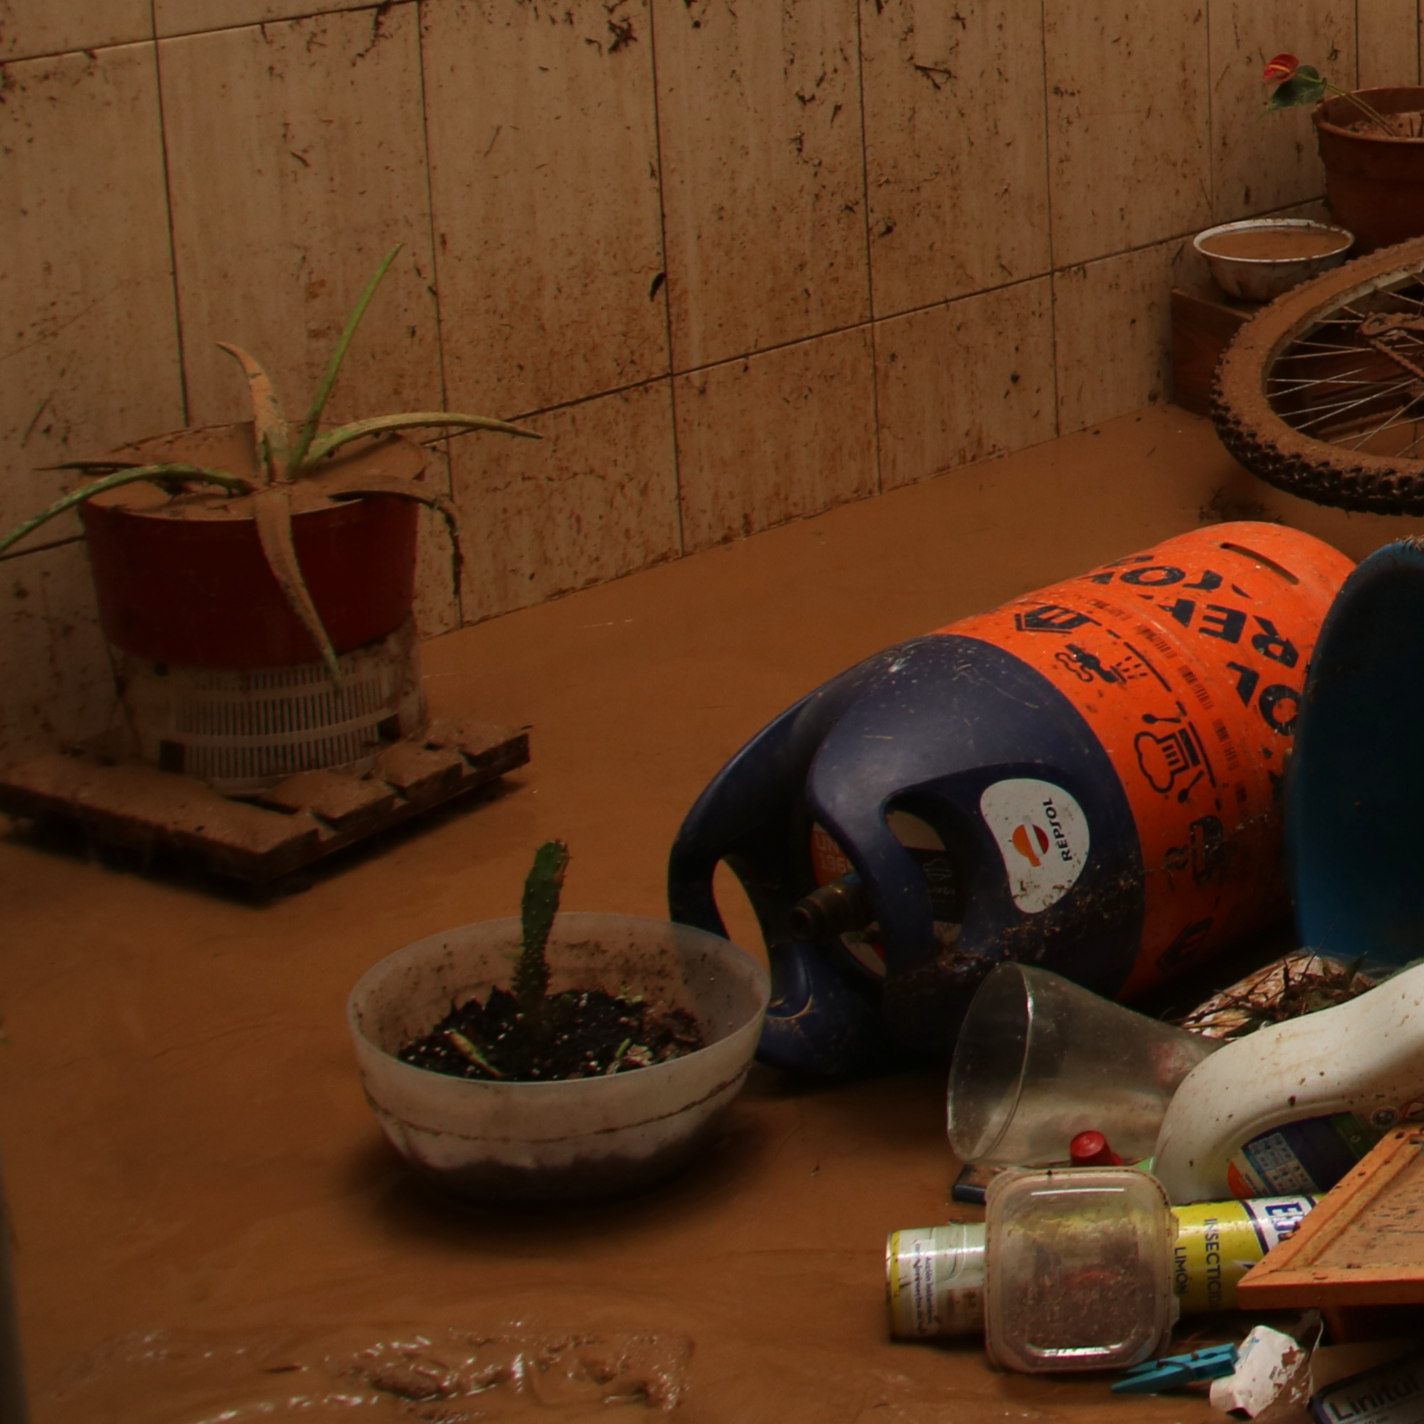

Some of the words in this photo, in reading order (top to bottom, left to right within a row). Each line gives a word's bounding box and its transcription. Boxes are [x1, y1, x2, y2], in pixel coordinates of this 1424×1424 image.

[1043, 798, 1073, 862] REPSOL
[1174, 1247, 1191, 1295] LIMÓN
[1329, 1374, 1420, 1422] Linitul
